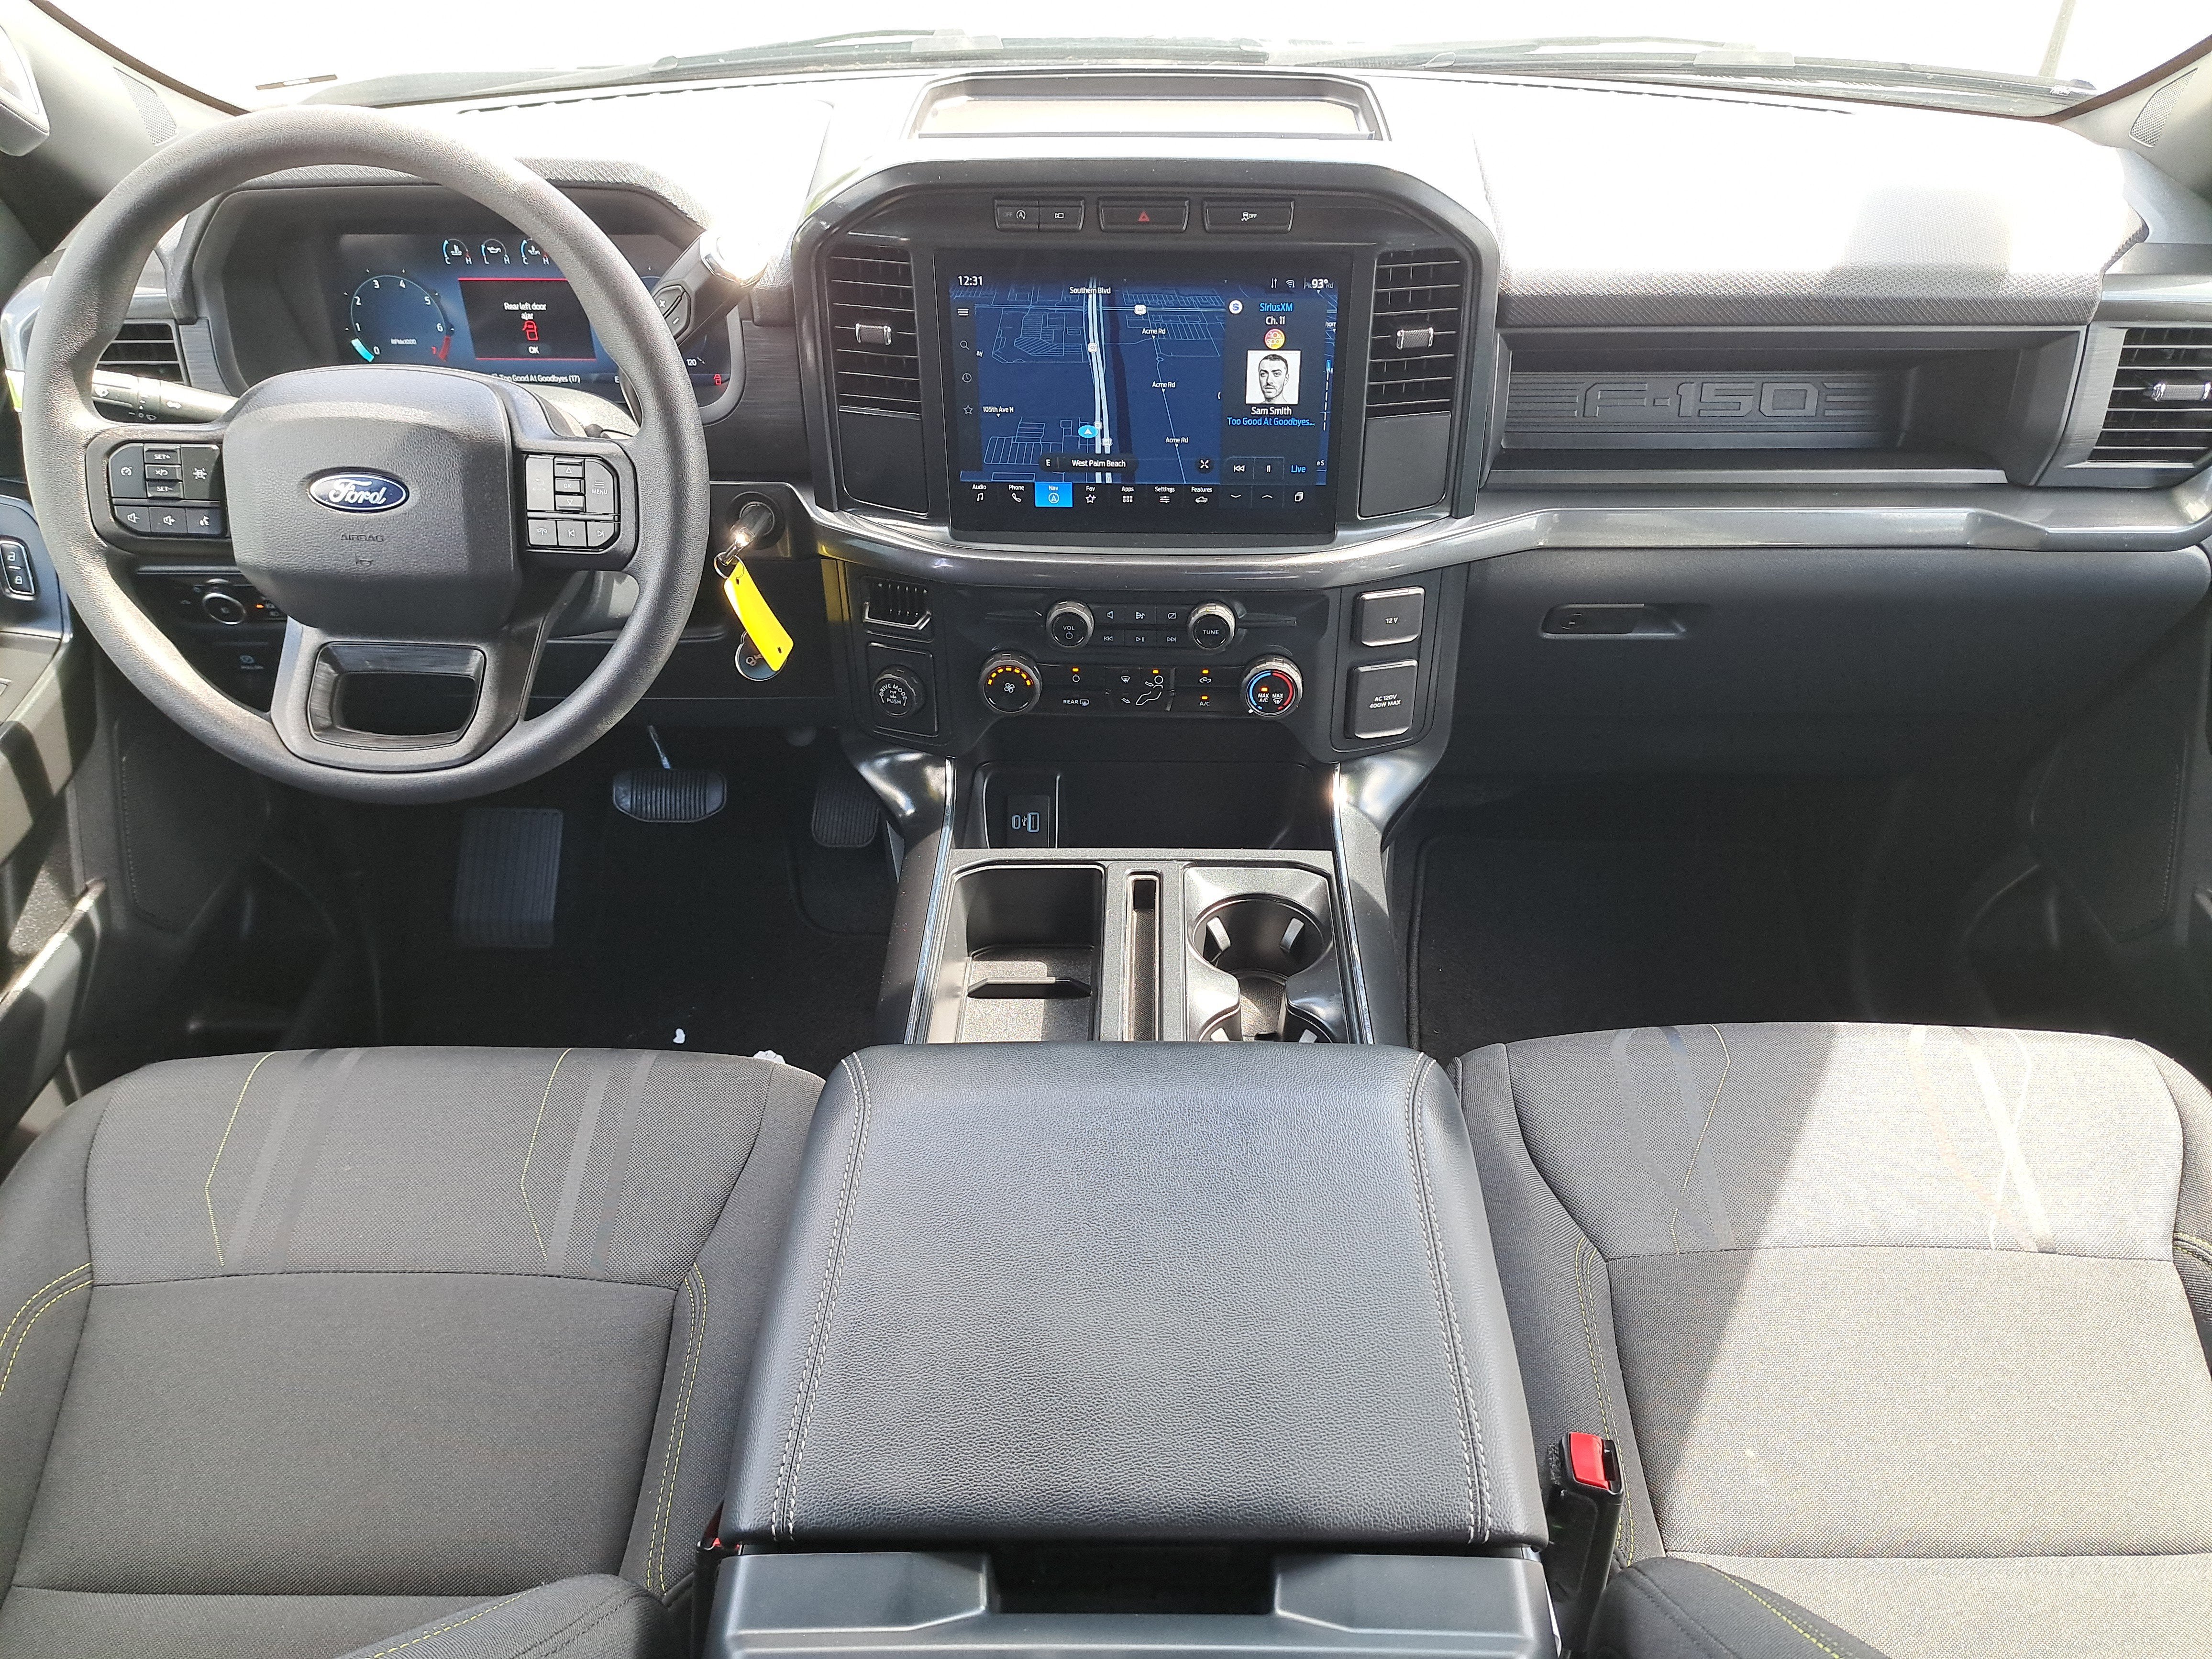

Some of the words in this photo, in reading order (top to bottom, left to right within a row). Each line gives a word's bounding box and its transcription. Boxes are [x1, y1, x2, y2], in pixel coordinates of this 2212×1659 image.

[373, 280, 379, 288] 3
[399, 280, 406, 288] 4
[958, 276, 983, 286] 12:31
[354, 296, 362, 305] 2
[424, 296, 431, 305] 5
[504, 302, 519, 310] Rear
[520, 302, 531, 310] left
[531, 302, 546, 310] door
[1260, 303, 1293, 311] SiriusXM
[521, 312, 533, 320] ajar
[1266, 316, 1278, 324] Ch.
[1279, 316, 1285, 324] 11
[355, 323, 361, 331] 1
[437, 323, 443, 332] 6
[373, 346, 380, 355] 0
[529, 346, 540, 354] OK
[538, 375, 568, 383] Goodbyes
[1582, 382, 1818, 418] F-150
[1270, 406, 1292, 415] Smith
[1243, 417, 1262, 425] Good
[329, 479, 387, 504] Ford
[879, 684, 891, 697] DRIVE
[893, 684, 907, 700] MODE
